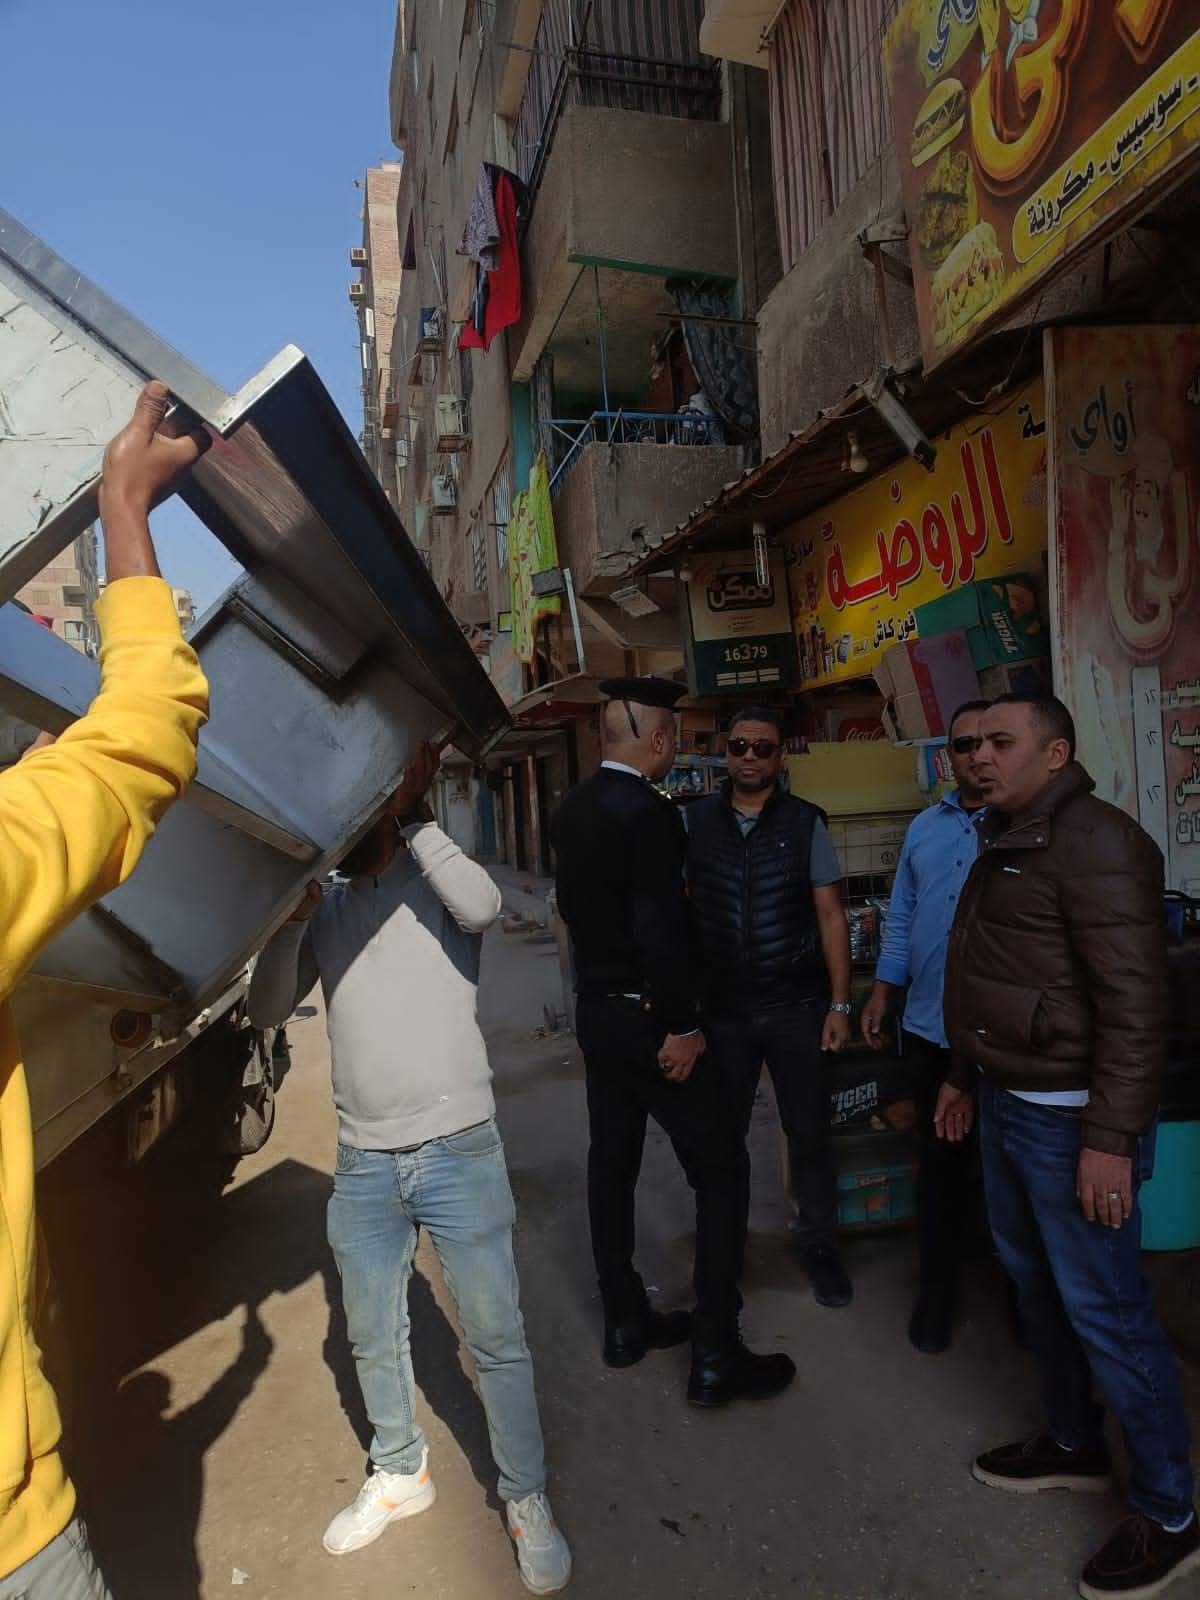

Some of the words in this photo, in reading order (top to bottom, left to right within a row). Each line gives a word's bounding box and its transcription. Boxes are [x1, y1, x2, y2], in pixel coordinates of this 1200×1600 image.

[1028, 161, 1093, 234] مكرونة
[822, 430, 1013, 611] الروضة
[723, 643, 768, 662] 16379
[873, 617, 895, 648] كاش
